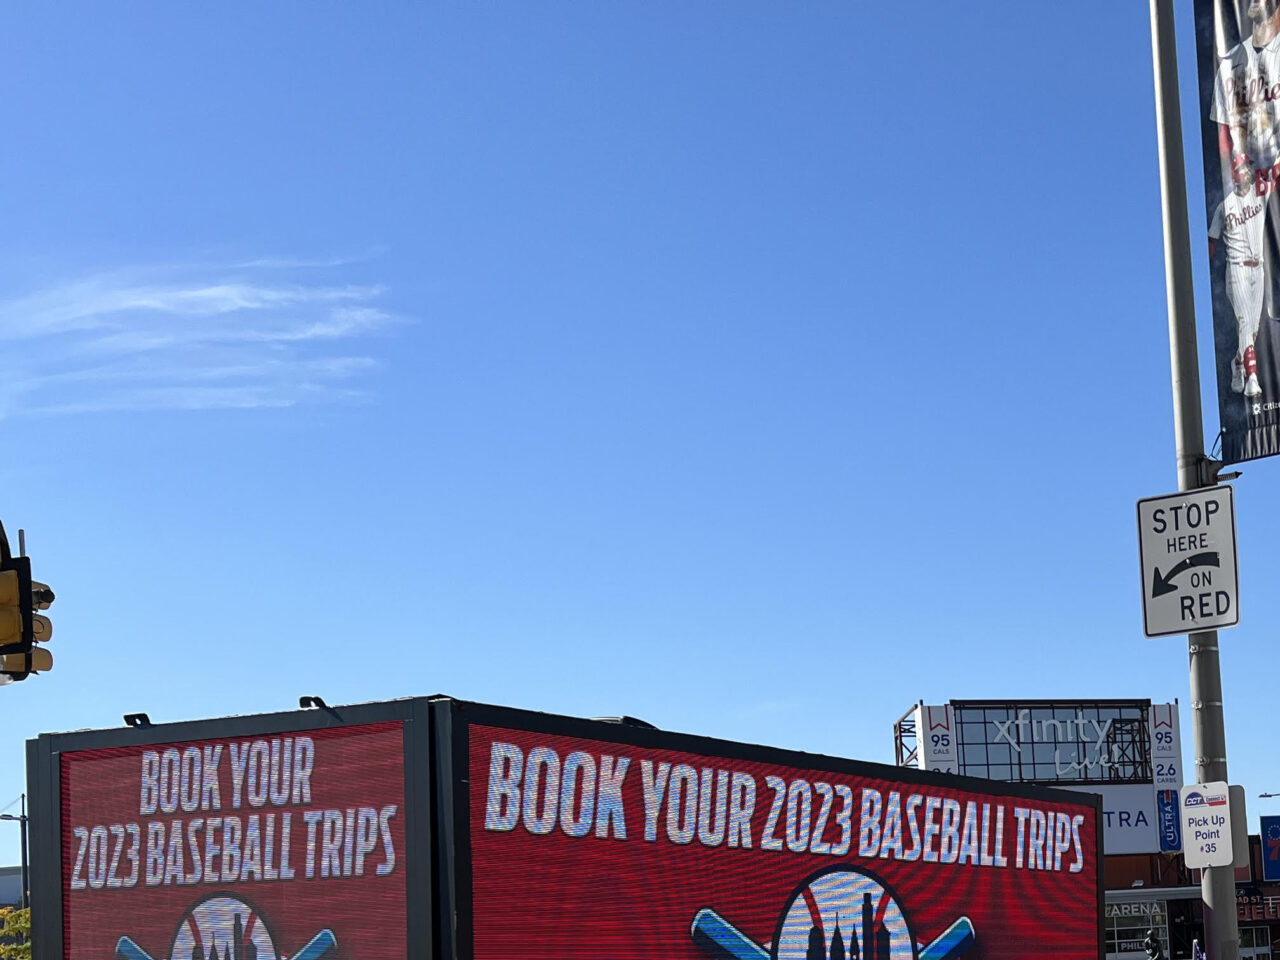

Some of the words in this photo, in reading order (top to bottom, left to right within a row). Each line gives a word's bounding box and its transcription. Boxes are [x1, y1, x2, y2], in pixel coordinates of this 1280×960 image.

[1226, 203, 1262, 229] Phillies
[1152, 500, 1220, 534] STOP
[1167, 533, 1208, 553] HERE
[1190, 570, 1212, 588] ON
[1180, 590, 1231, 621] RED
[931, 734, 950, 747] 95
[993, 709, 1114, 752] xfinity
[1155, 732, 1173, 744] 95
[1054, 743, 1120, 776] Live!
[1156, 764, 1176, 776] 2.6
[140, 745, 224, 816] BOOK
[228, 737, 316, 809] YOUR
[484, 741, 631, 841] BOOK
[641, 760, 757, 850] YOUR
[759, 775, 854, 856] 2023
[857, 787, 1009, 869] BASEBALL
[1013, 806, 1085, 874] TRIPS
[1165, 805, 1175, 841] ULTRA
[1188, 816, 1208, 827] Pick
[1211, 815, 1225, 827] Up
[71, 822, 141, 889] 2023
[145, 812, 296, 887] BASEBALL
[303, 805, 397, 879] TRIPS
[1195, 829, 1220, 840] Point
[1111, 903, 1161, 917] ARENA
